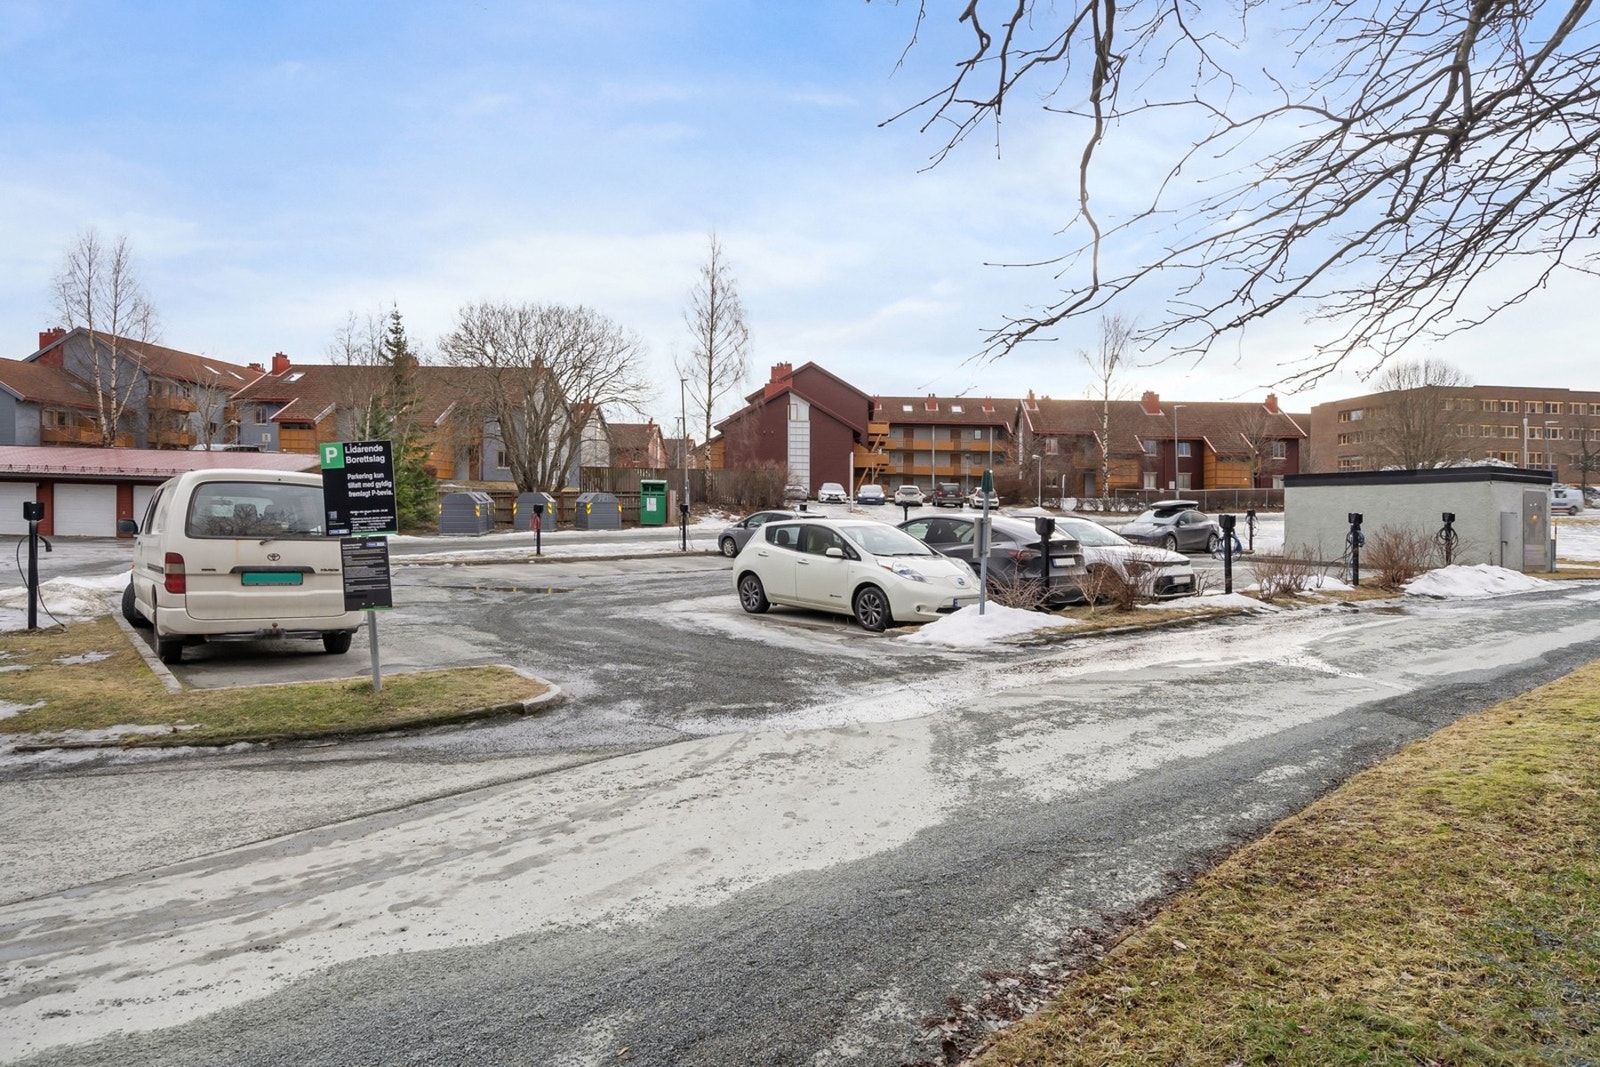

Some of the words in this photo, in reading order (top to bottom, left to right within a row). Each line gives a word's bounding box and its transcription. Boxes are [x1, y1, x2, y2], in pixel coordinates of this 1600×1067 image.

[345, 444, 383, 453] Lidarende
[326, 447, 338, 463] P
[346, 455, 385, 464] Borettslag
[375, 480, 392, 488] gyldig
